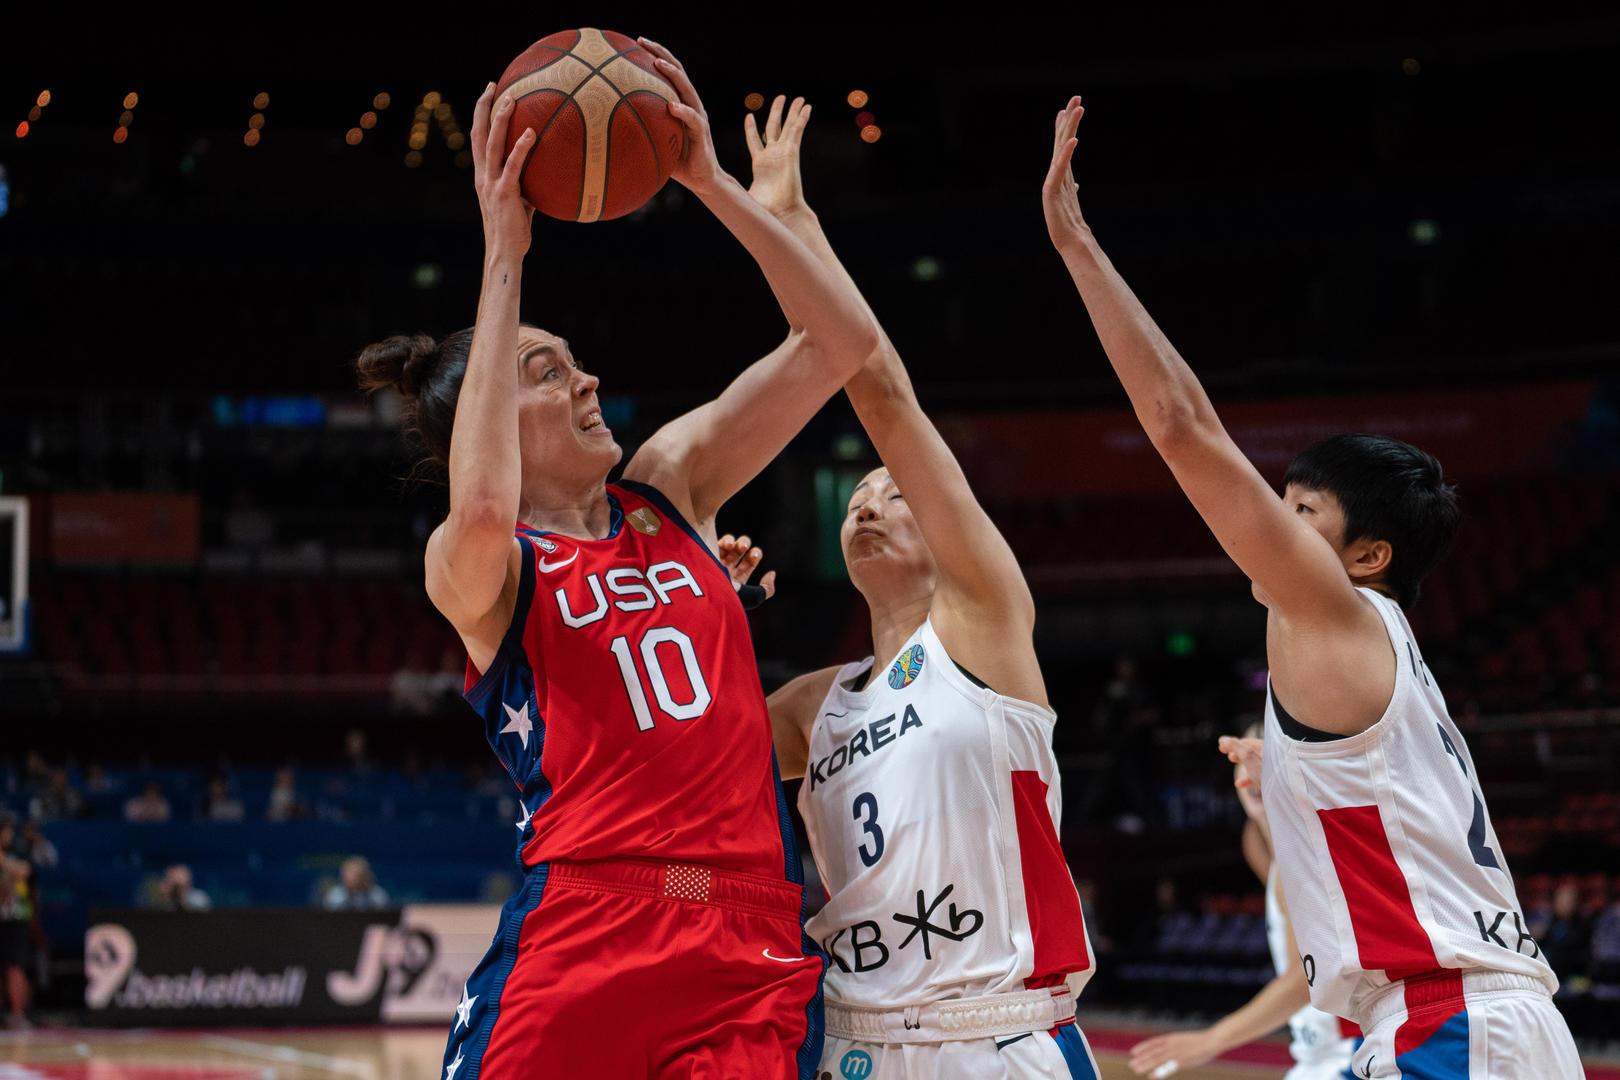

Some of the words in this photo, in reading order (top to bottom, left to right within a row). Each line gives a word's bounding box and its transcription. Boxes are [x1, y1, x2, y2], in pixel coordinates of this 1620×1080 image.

[555, 560, 705, 630] USA
[610, 626, 712, 732] 10
[809, 703, 923, 793] KOREA
[852, 791, 885, 868] 3
